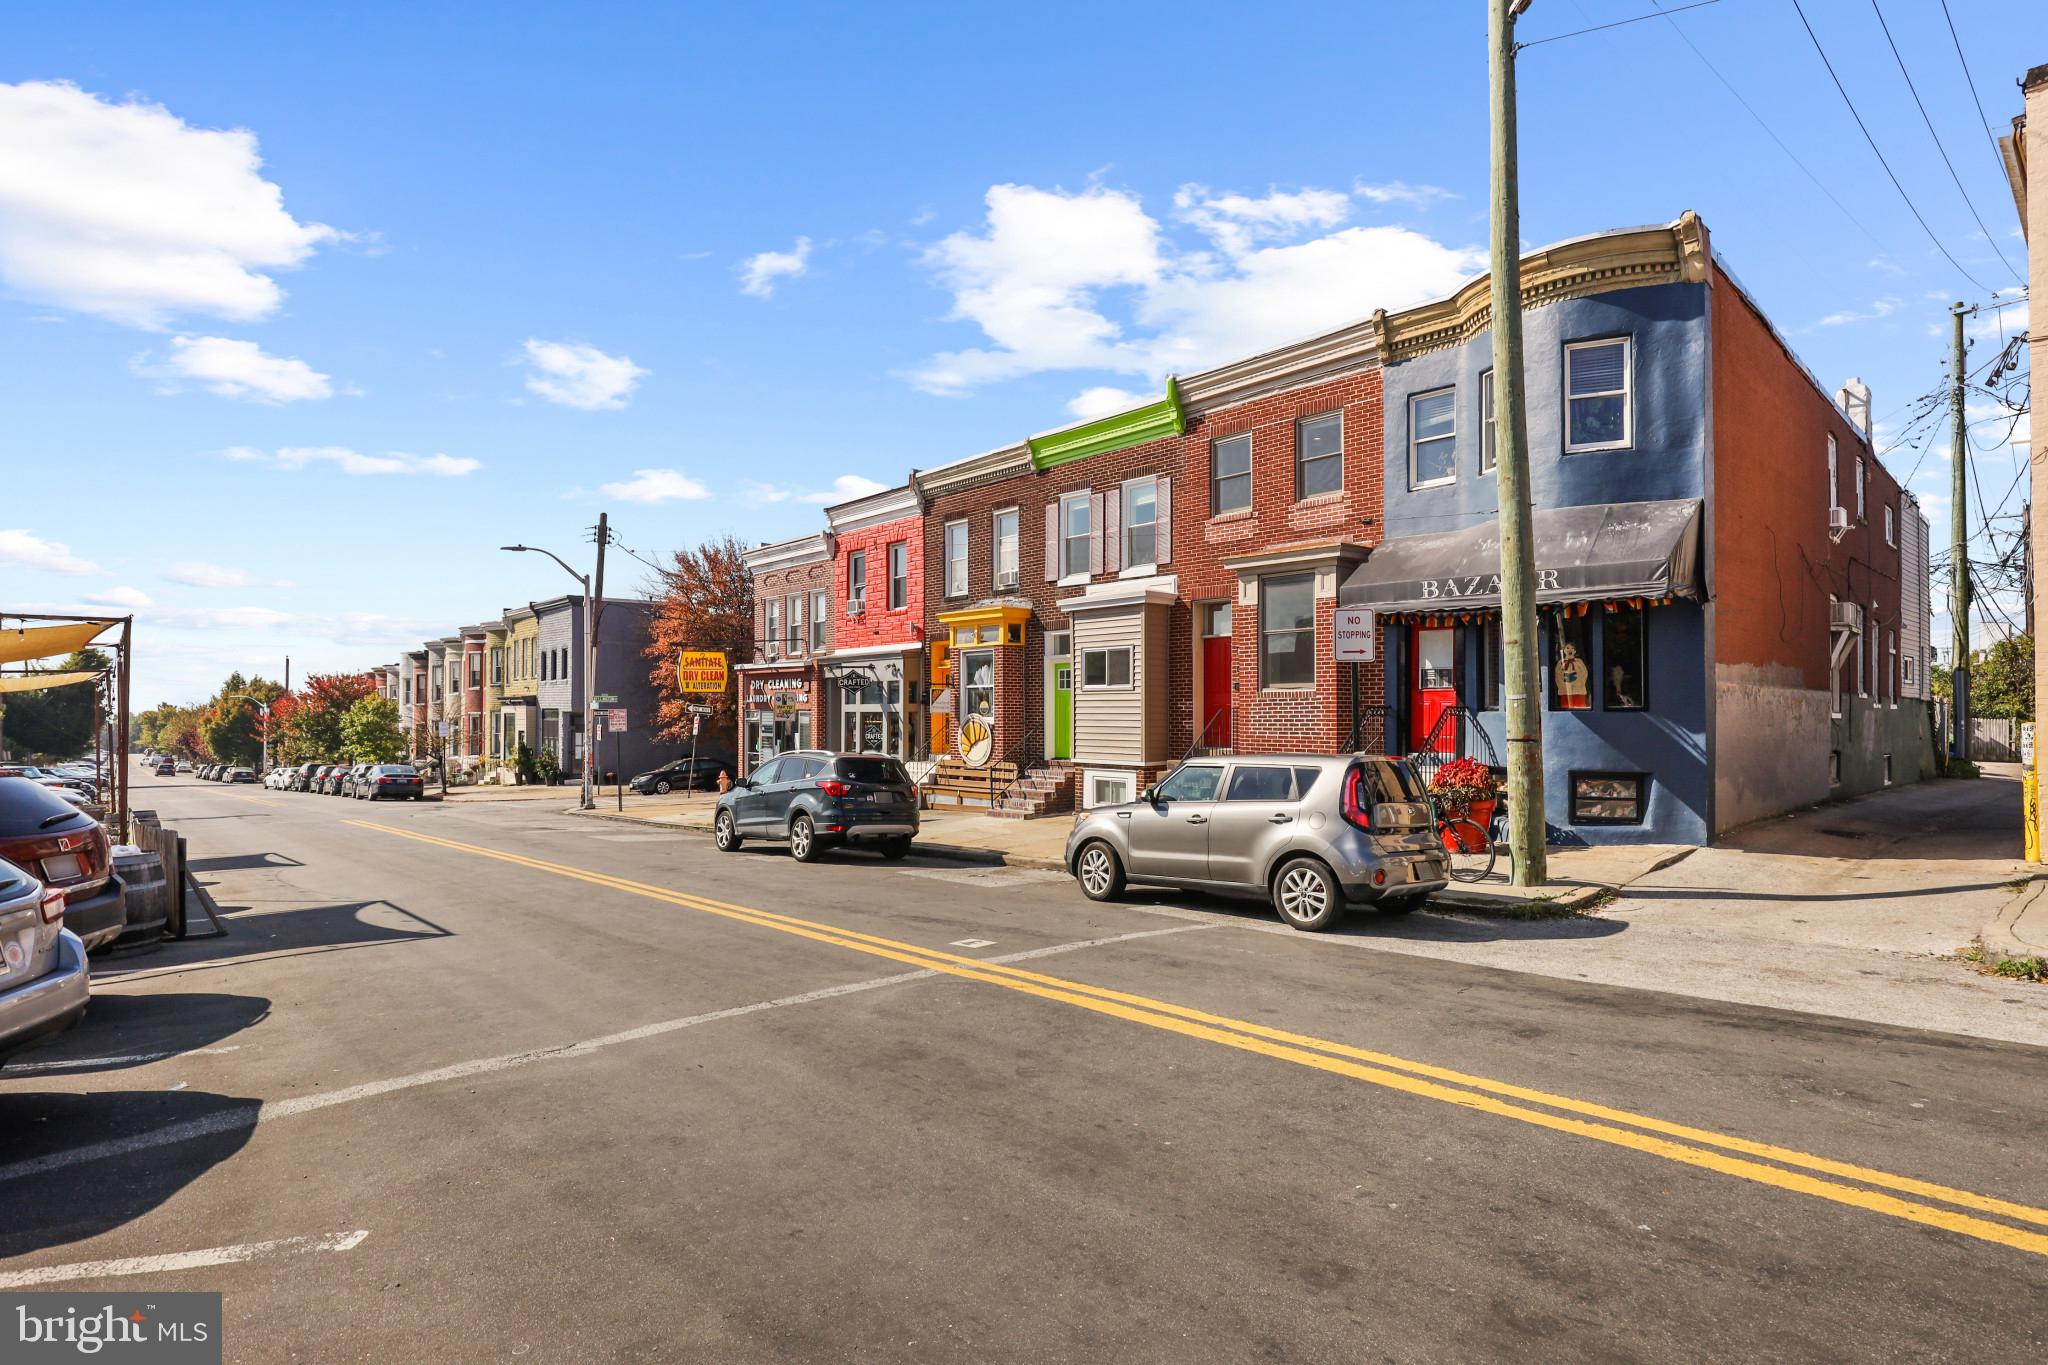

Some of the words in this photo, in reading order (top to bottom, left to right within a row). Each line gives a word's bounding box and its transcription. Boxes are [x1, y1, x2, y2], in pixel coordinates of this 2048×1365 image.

[1419, 569, 1562, 599] BAZAR
[1347, 616, 1361, 625] NO
[1337, 630, 1371, 639] STOPPING
[683, 670, 699, 681] DRY
[700, 670, 725, 681] CLEAN
[750, 679, 764, 690] DRY
[767, 678, 803, 690] CLEANING
[839, 678, 869, 686] CRAFTED
[746, 694, 771, 703] LAUNDRY
